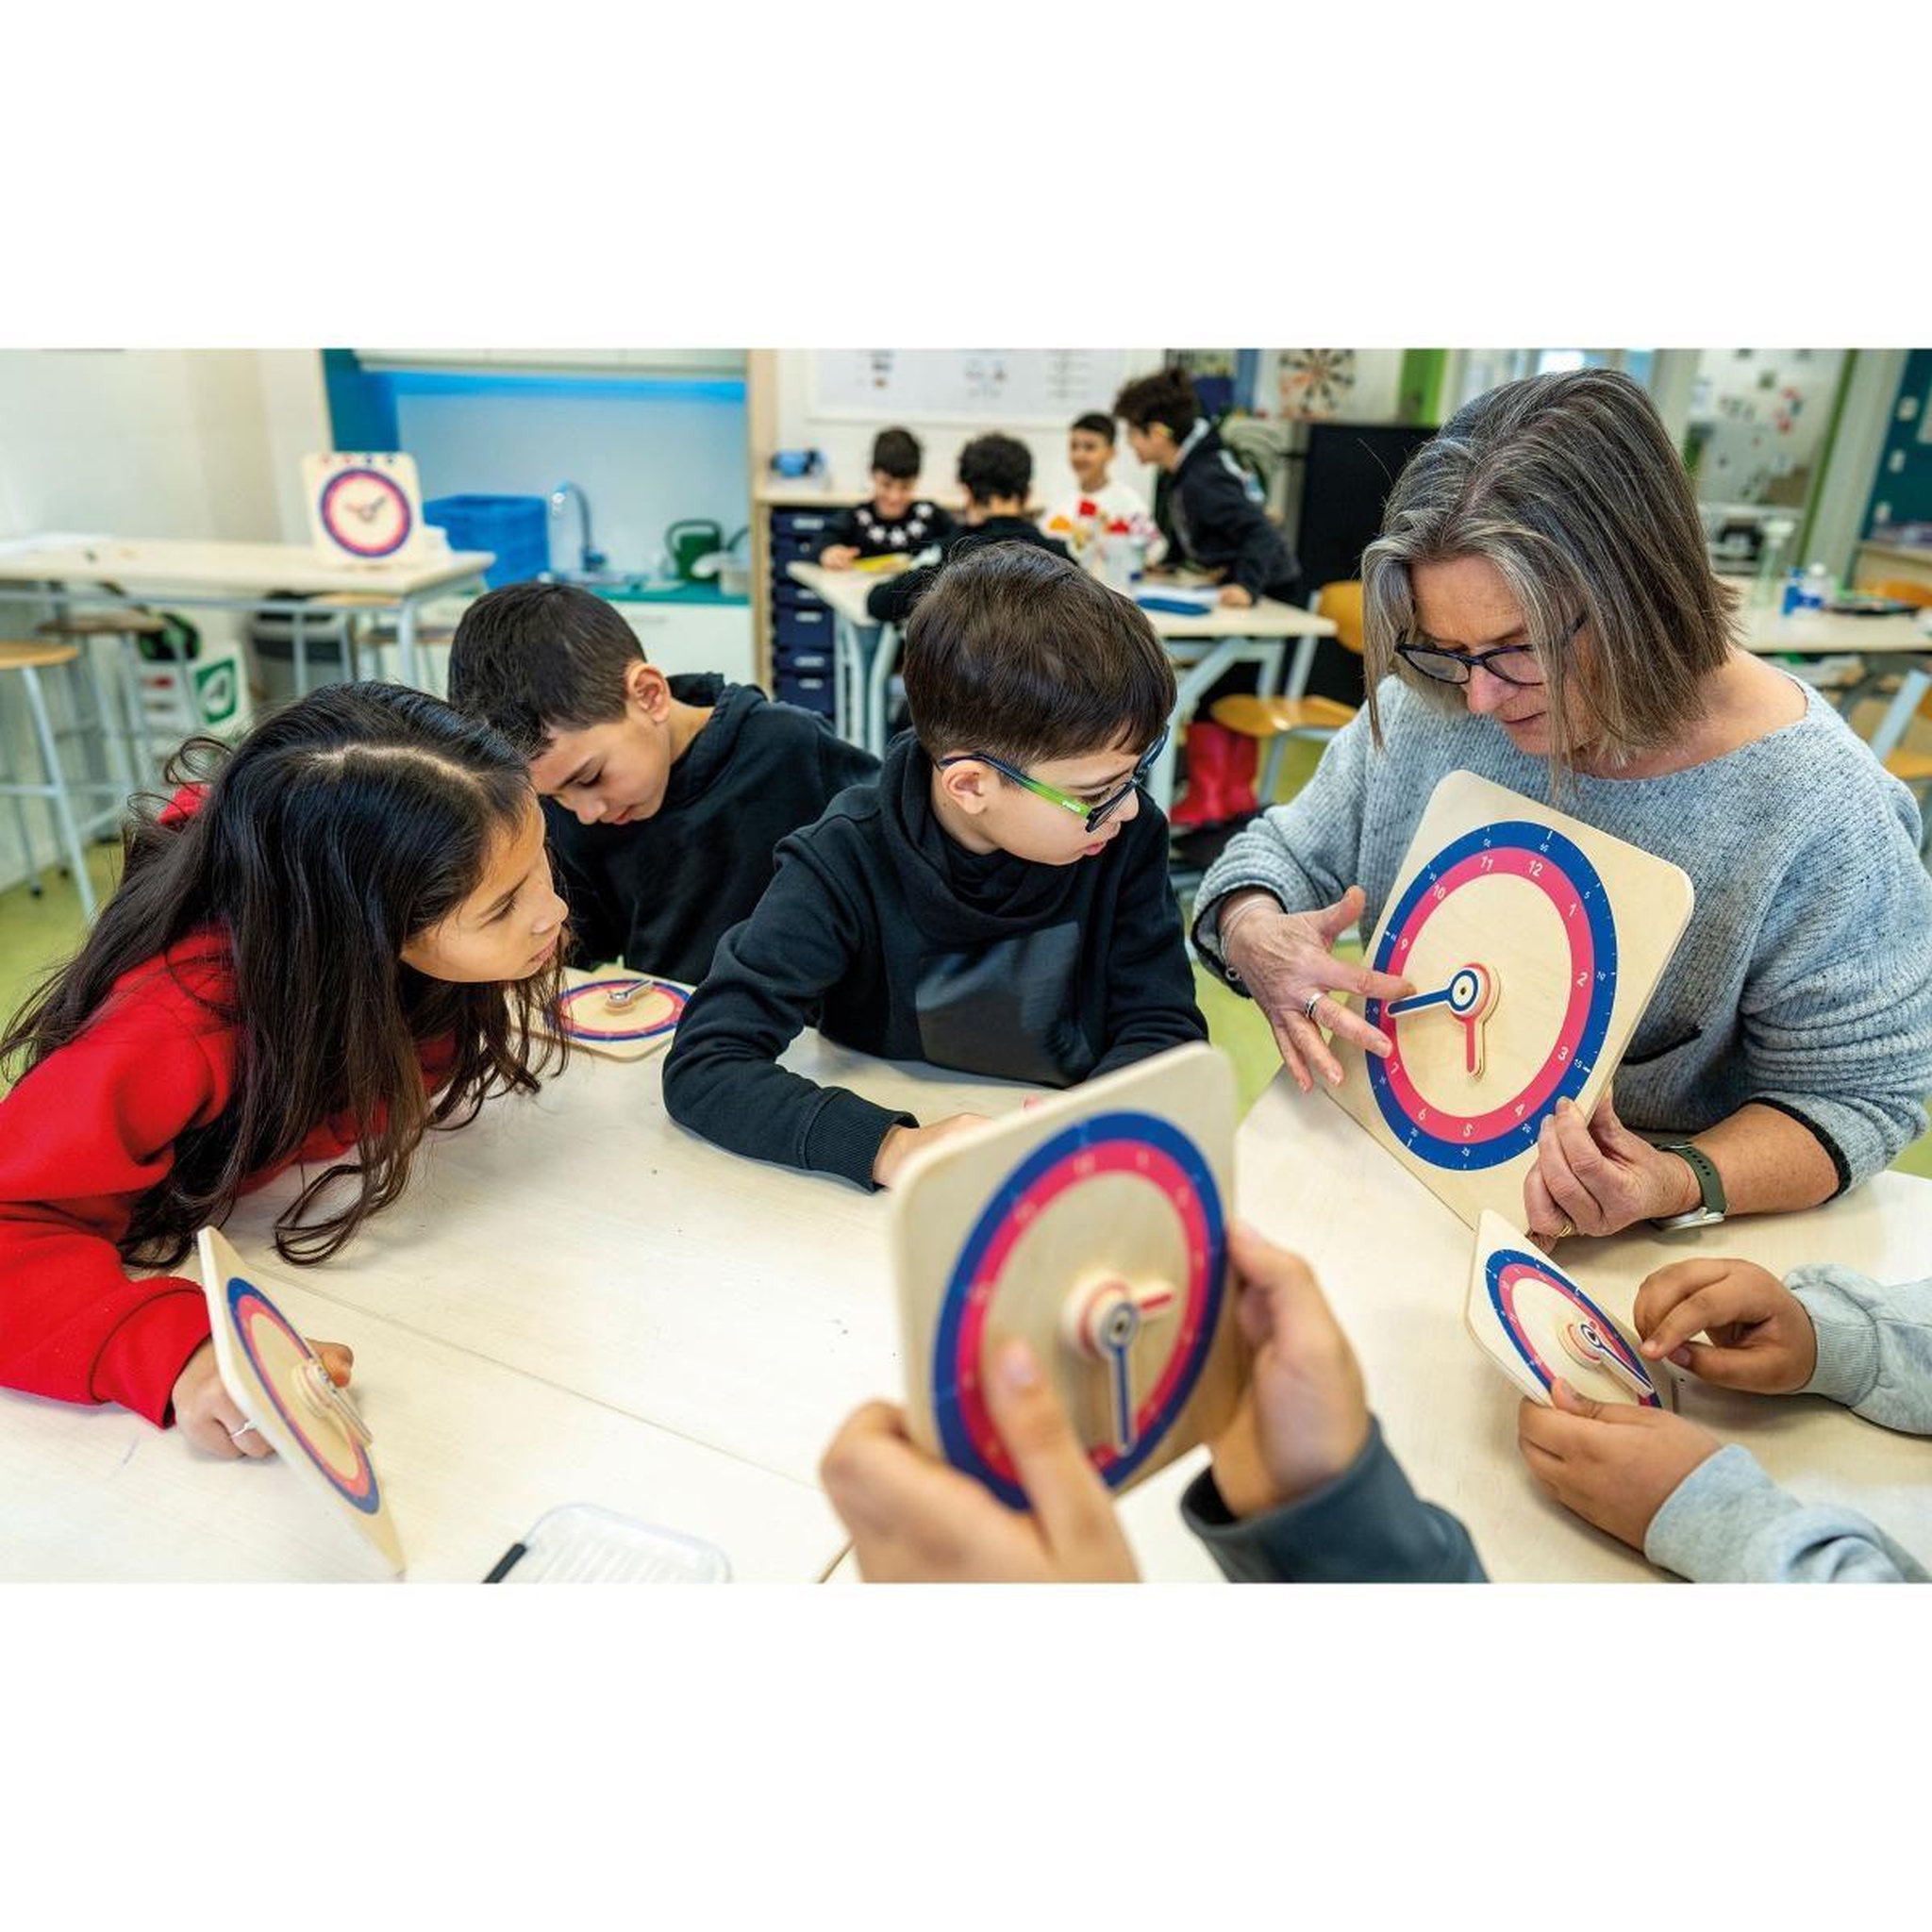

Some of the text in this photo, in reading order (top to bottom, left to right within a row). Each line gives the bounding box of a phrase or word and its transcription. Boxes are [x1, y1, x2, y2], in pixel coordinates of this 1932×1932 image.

[1480, 855, 1494, 872] 11
[1528, 859, 1543, 877] 12
[1433, 883, 1446, 900] 10
[1584, 891, 1591, 900] 5
[1569, 903, 1577, 918] 1
[1400, 937, 1408, 951] 9
[1576, 971, 1589, 988] 2
[1557, 1045, 1569, 1061] 3
[1391, 1061, 1399, 1075] 7
[1418, 1108, 1427, 1122] 6
[1514, 1103, 1525, 1116] 4
[1462, 1123, 1474, 1138] 5
